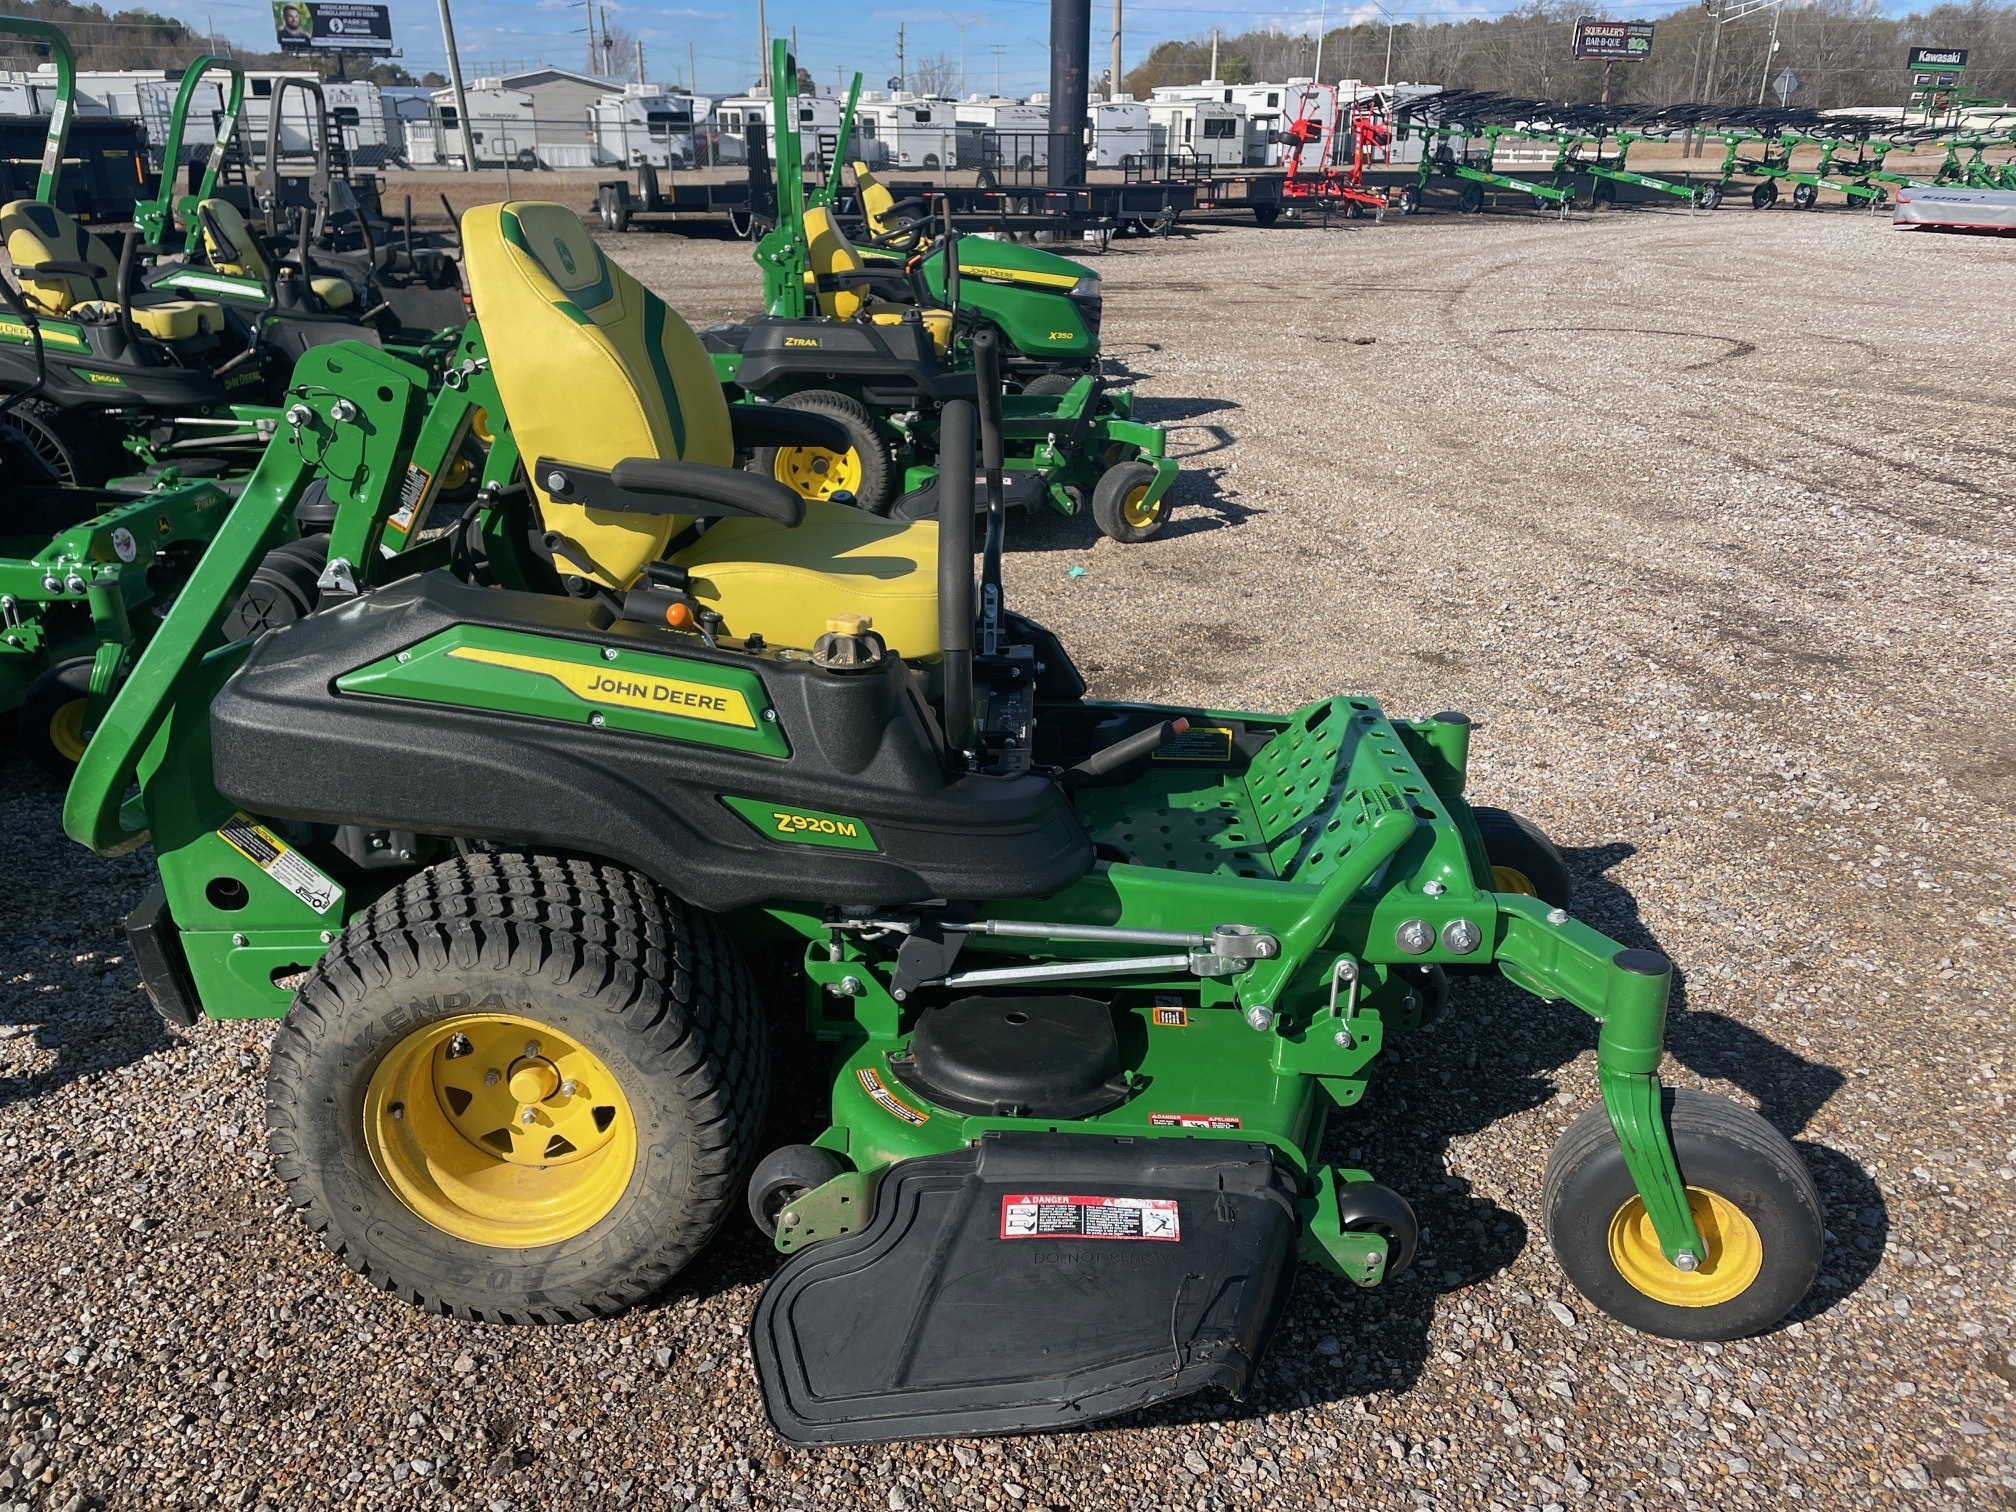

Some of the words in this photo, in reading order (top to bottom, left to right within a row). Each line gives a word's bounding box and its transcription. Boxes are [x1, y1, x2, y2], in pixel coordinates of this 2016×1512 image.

[1584, 26, 1625, 37] SQUEALER'S
[1919, 50, 1961, 63] Kawasaki
[328, 94, 359, 103] PUMA
[970, 266, 989, 275] JOHN
[990, 268, 1014, 278] DEERE
[5, 324, 34, 336] DEER
[1049, 331, 1074, 340] X350
[785, 337, 818, 347] ZTRAK
[588, 675, 648, 698] JOHN
[652, 684, 727, 711] DEERE
[773, 812, 857, 837] Z920M
[251, 823, 276, 844] CAUTION
[353, 992, 507, 1055] KENDA
[1032, 1195, 1070, 1204] DANGER
[1735, 1174, 1799, 1268] CARLISLE
[1034, 1252, 1060, 1264] DO
[1068, 1252, 1102, 1264] NOT
[1110, 1252, 1181, 1264] REMOVE
